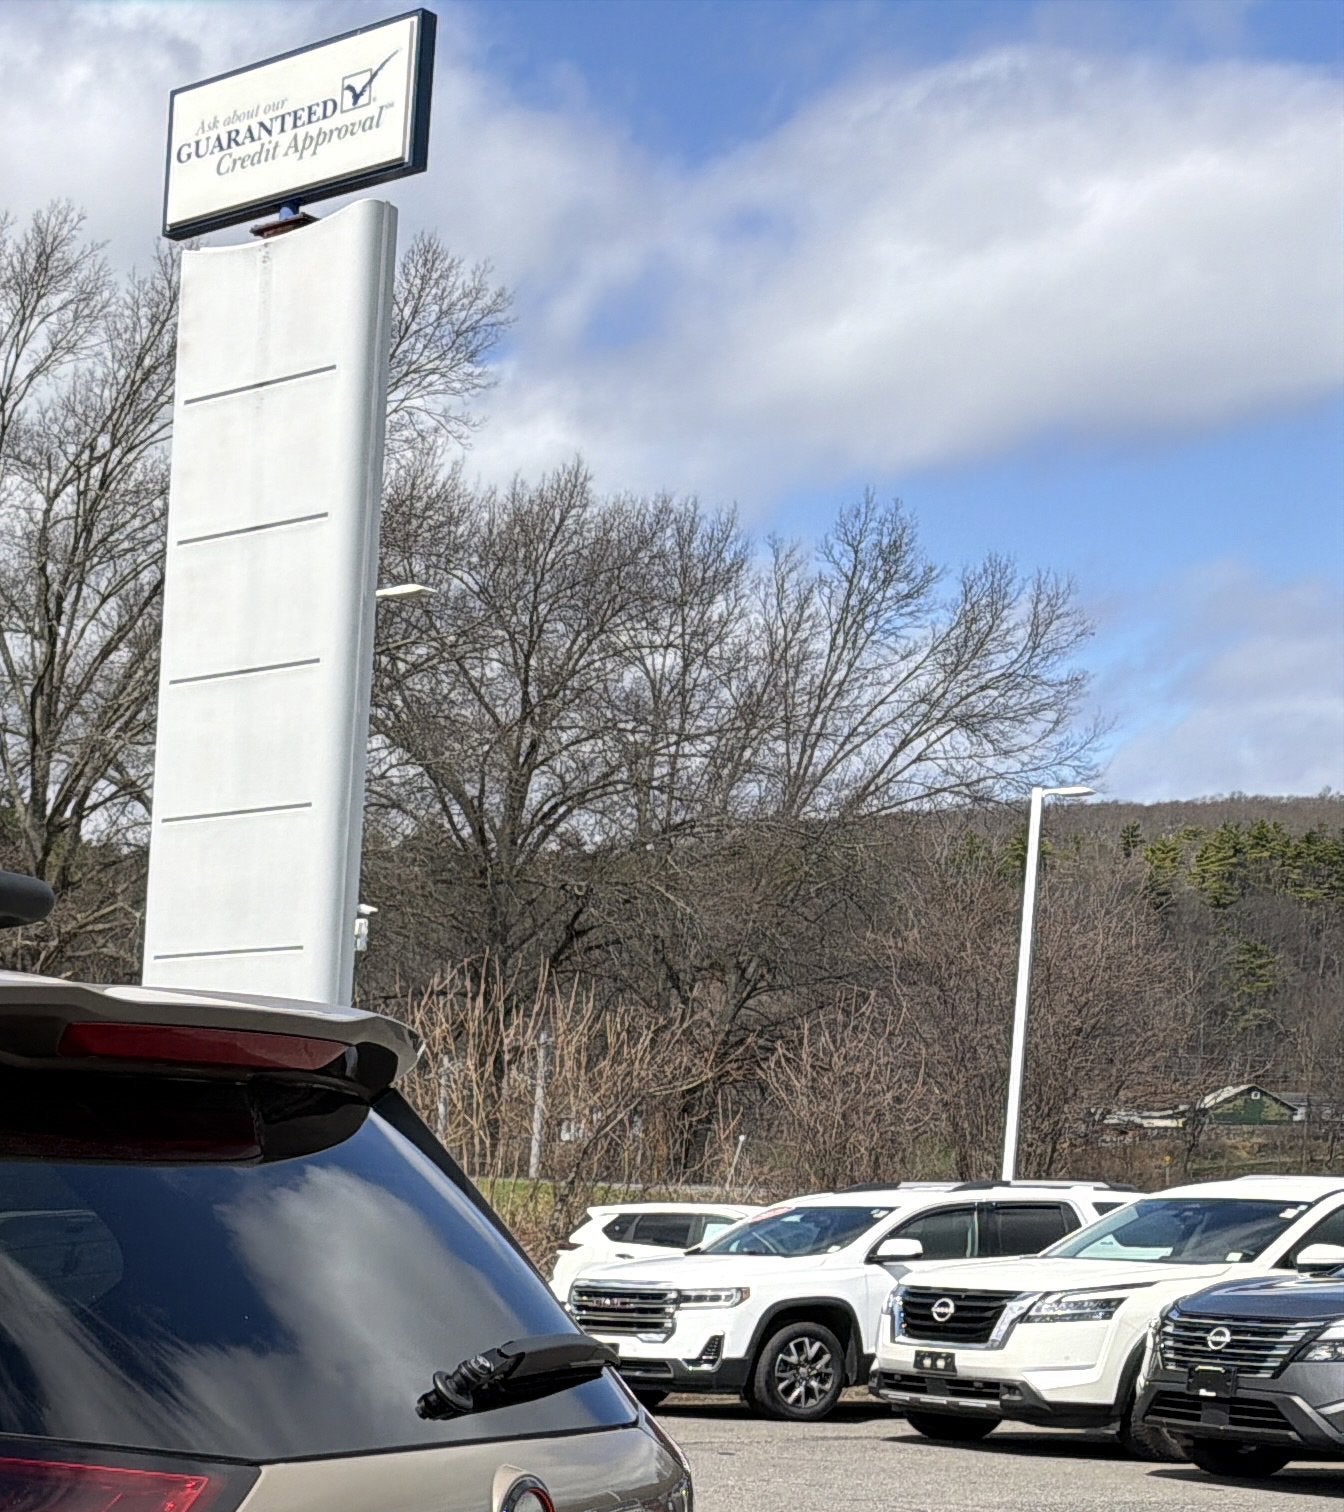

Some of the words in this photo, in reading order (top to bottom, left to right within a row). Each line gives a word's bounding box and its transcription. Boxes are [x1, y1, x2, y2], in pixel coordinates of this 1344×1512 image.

[176, 98, 337, 164] GUARANTEED
[195, 118, 220, 136] Ask
[223, 104, 259, 126] about
[263, 98, 287, 116] our
[216, 142, 280, 176] Credit
[283, 105, 385, 162] Approval
